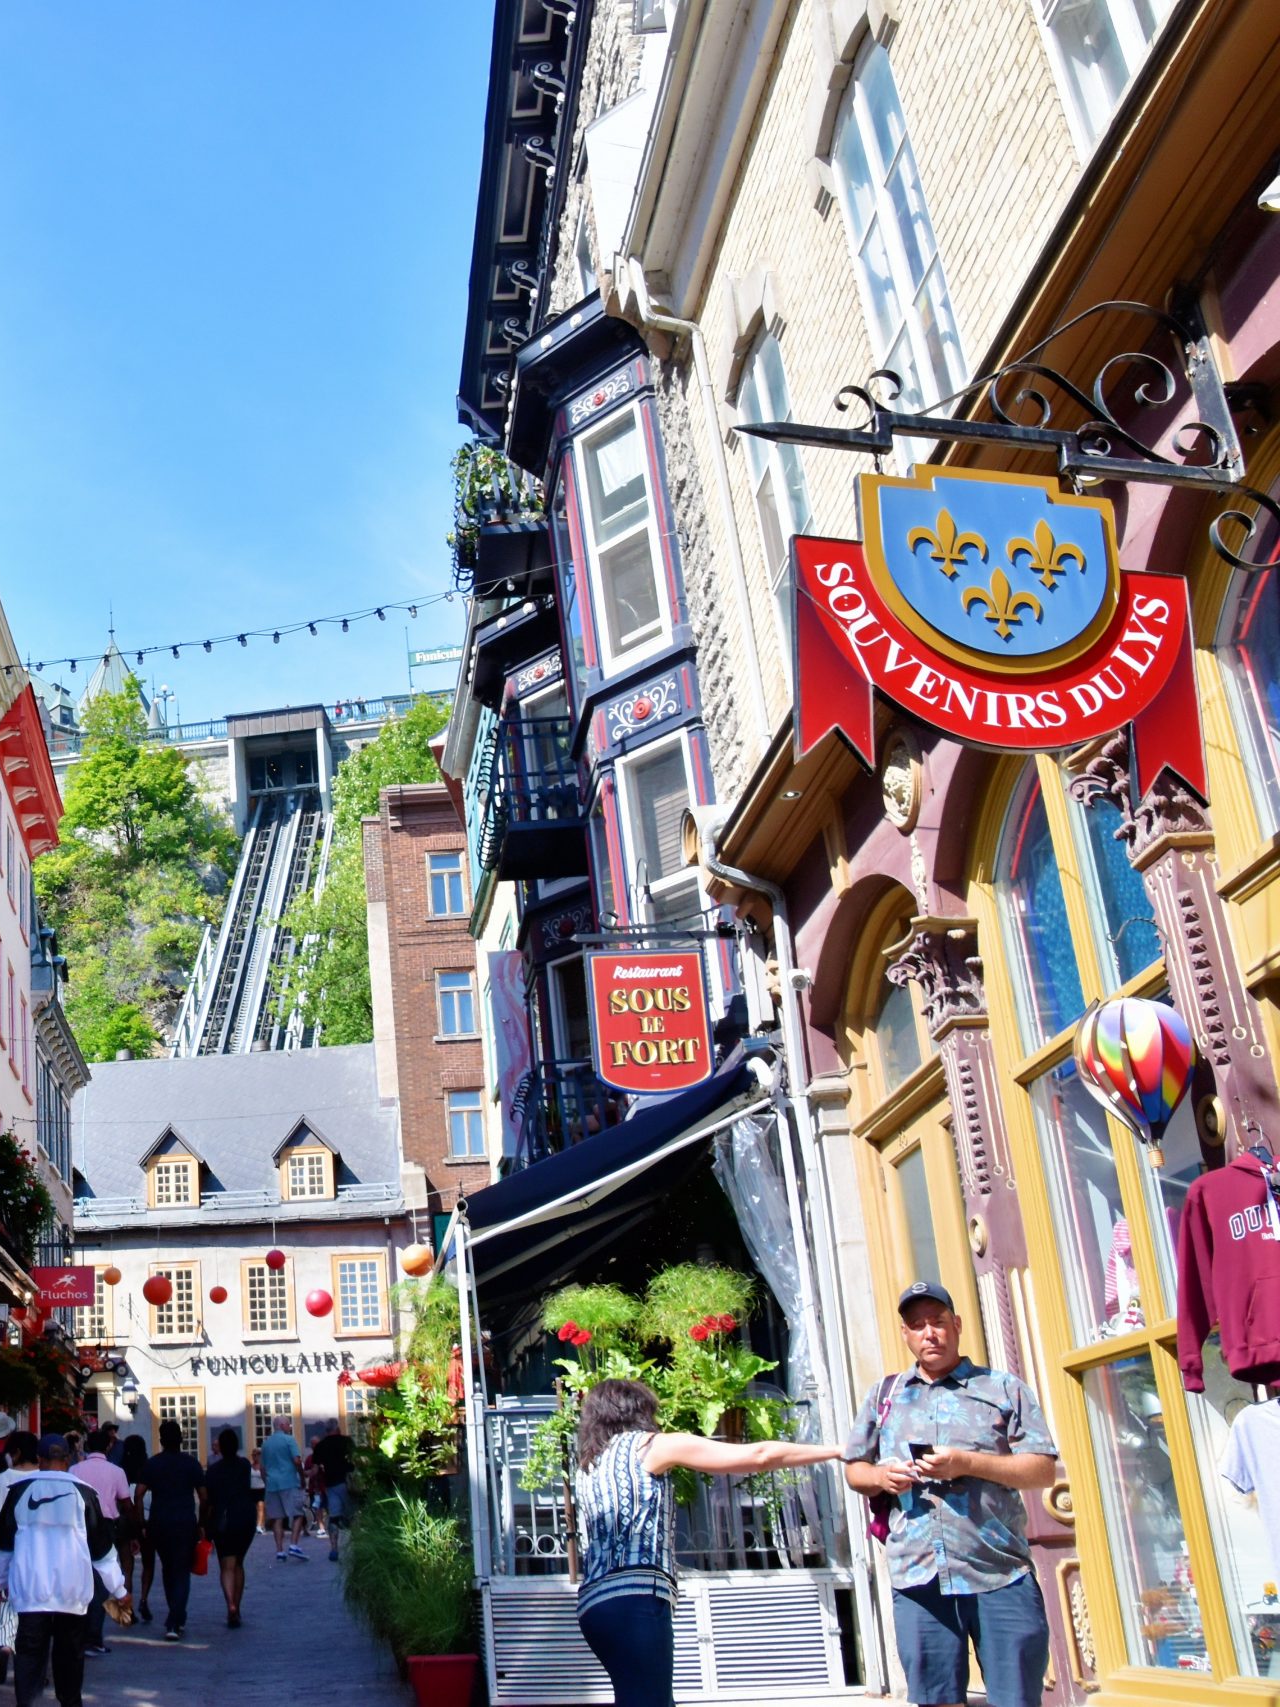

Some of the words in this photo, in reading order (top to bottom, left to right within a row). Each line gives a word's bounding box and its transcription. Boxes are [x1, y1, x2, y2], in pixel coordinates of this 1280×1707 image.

[815, 562, 1067, 728] SOUVENIRS
[1067, 665, 1126, 718] DU
[1111, 593, 1170, 679] LYS
[613, 965, 683, 979] Restaurant
[609, 986, 691, 1015] SOUS
[640, 1016, 665, 1034] LE
[610, 1037, 700, 1067] FORT
[40, 1290, 88, 1300] Fluchos
[190, 1350, 355, 1376] FUNICULAIRE
